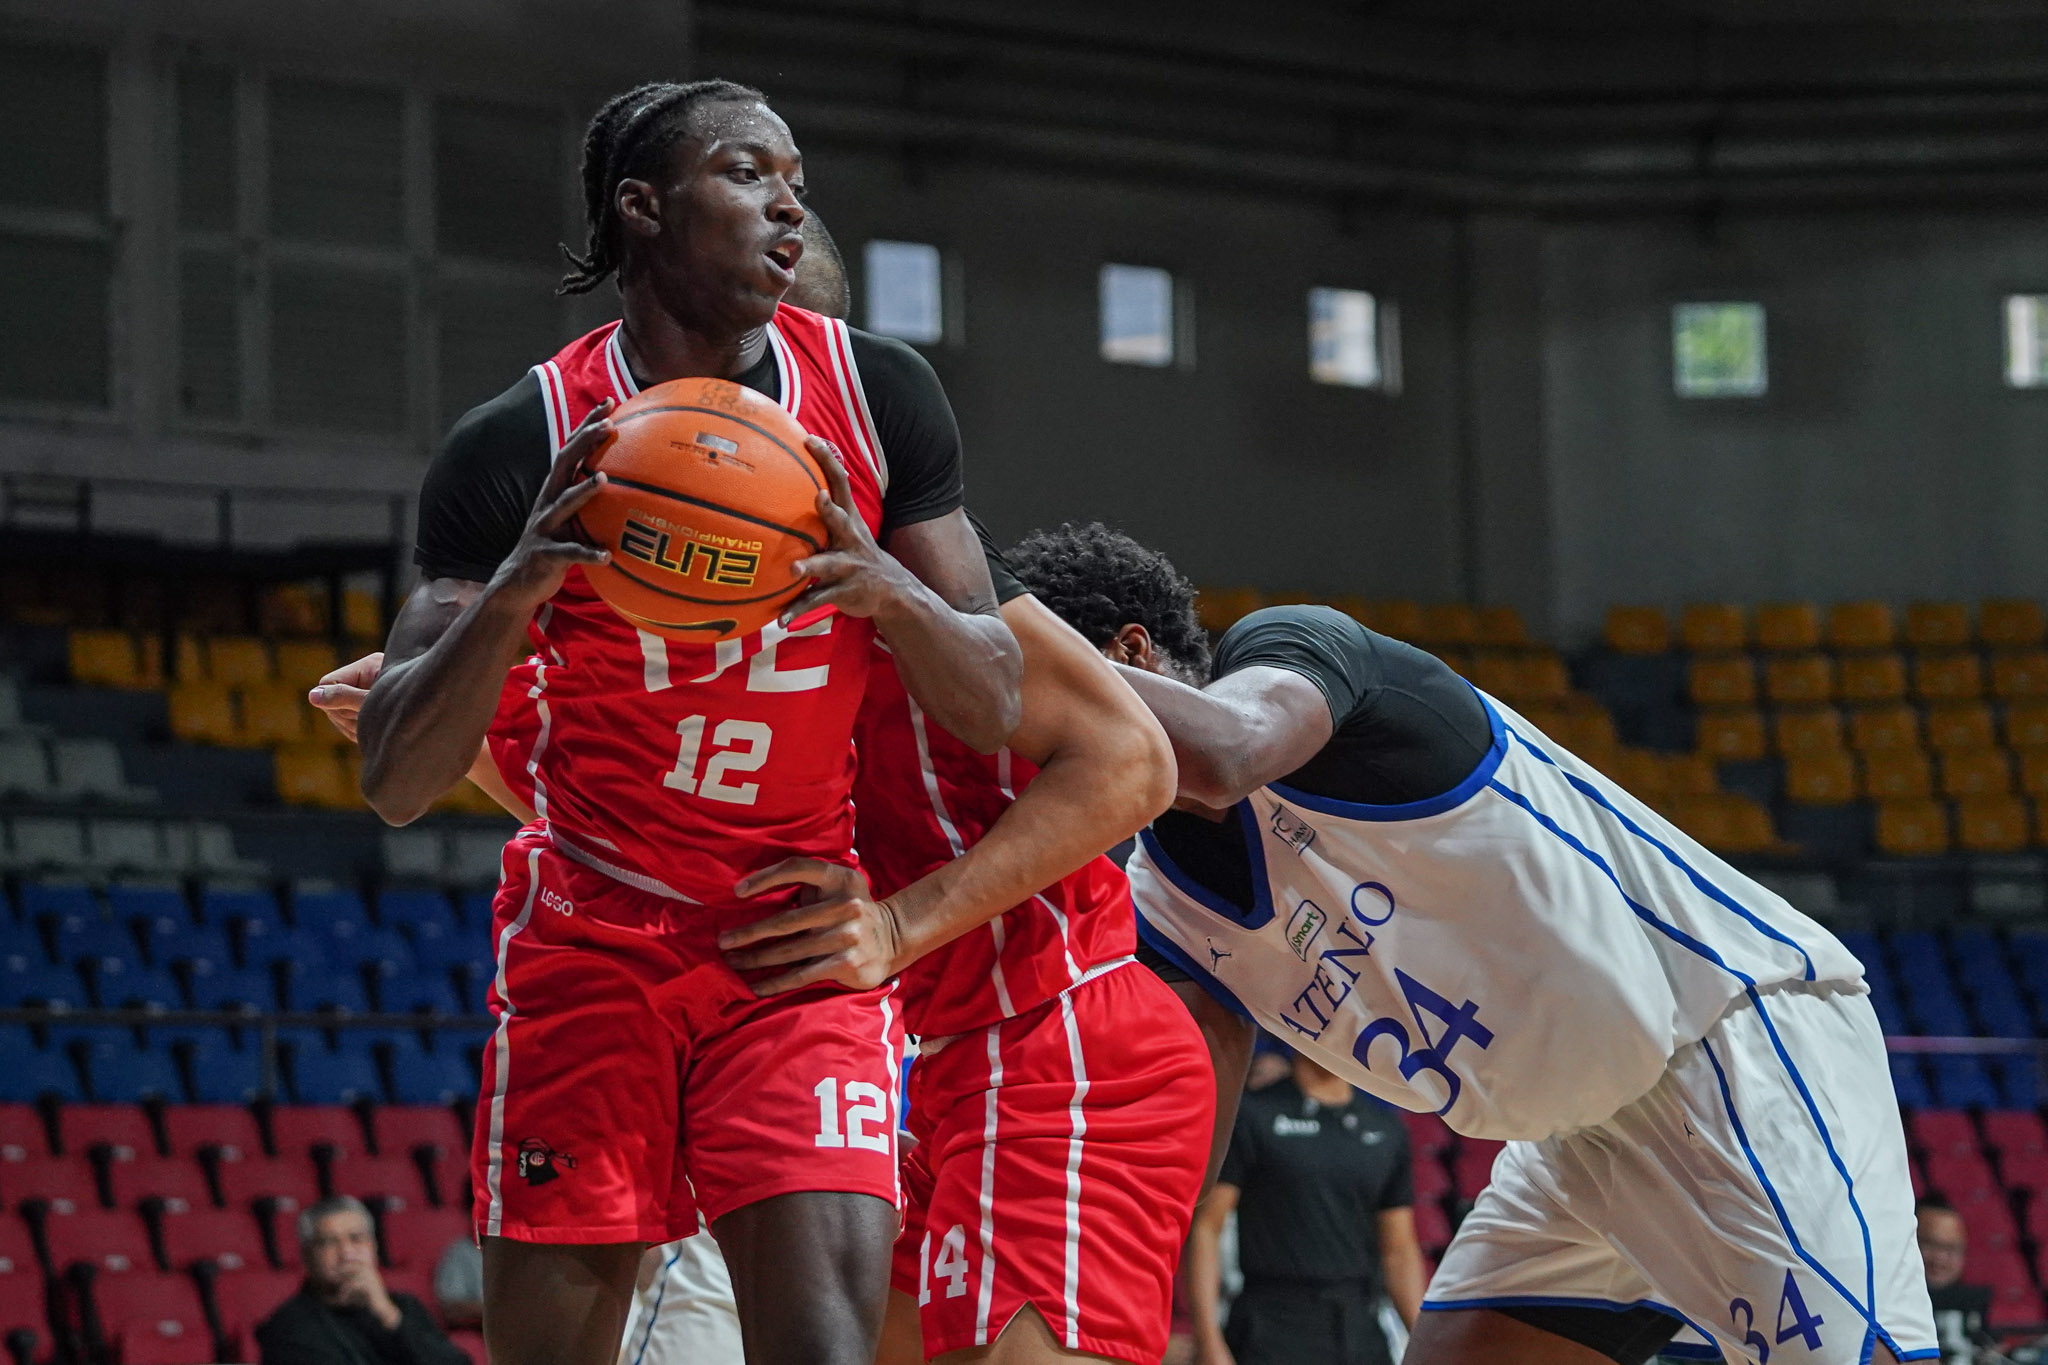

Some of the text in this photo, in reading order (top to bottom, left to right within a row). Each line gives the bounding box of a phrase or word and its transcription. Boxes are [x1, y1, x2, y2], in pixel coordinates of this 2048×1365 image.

[618, 518, 761, 587] ELITE
[627, 508, 763, 552] CHAMPIONSHIP
[663, 714, 773, 806] 12
[1353, 967, 1495, 1117] 34
[814, 1077, 890, 1156] 12
[918, 1223, 969, 1308] 14
[1729, 1267, 1824, 1365] 34
